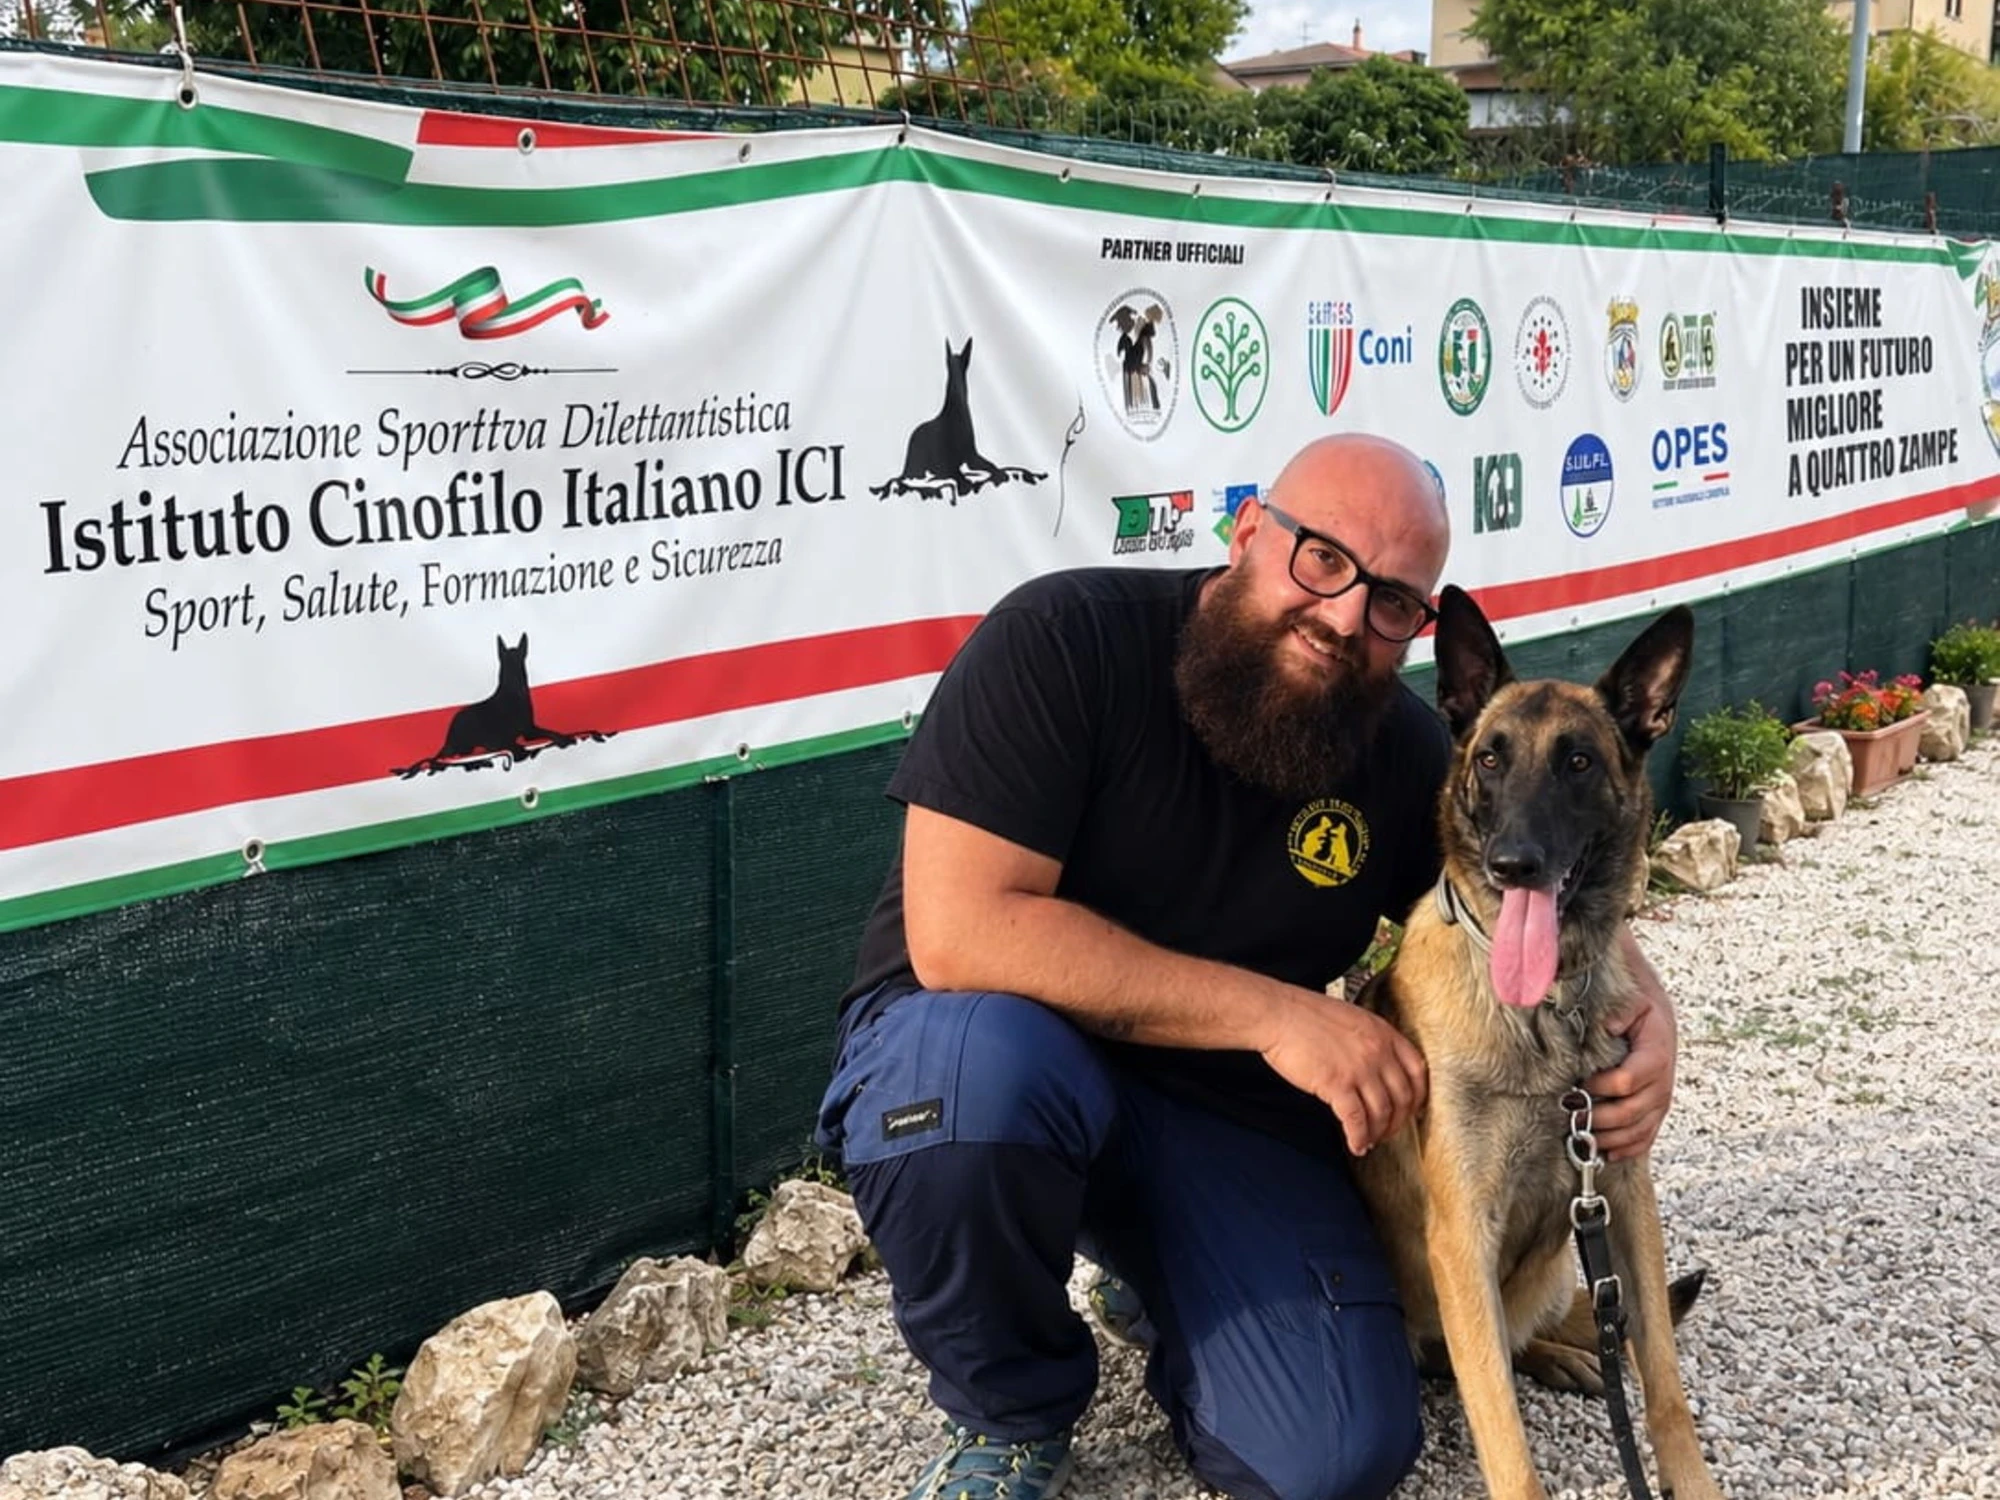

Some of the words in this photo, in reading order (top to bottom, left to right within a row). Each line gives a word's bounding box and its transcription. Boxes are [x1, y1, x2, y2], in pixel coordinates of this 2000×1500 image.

[1100, 237, 1173, 262] PARTNER
[1176, 241, 1245, 265] UFFICIALI
[1801, 286, 1882, 330] INSIEME
[1358, 325, 1412, 366] Coni
[1785, 340, 1824, 388] PER
[1828, 339, 1855, 383] UN
[1860, 335, 1933, 380] FUTURO
[116, 409, 361, 470] Associazione
[559, 391, 790, 449] Dilettantistica
[1786, 388, 1884, 443] MIGLIORE
[1651, 421, 1730, 472] OPES
[1787, 453, 1803, 498] A
[1806, 437, 1895, 498] QUATTRO
[1898, 427, 1959, 474] ZAMPE
[39, 489, 290, 575] Istituto
[309, 467, 543, 548] Cinofilo
[562, 458, 762, 529] Italiano
[775, 444, 846, 507] ICI
[144, 583, 266, 652] Sport,
[282, 569, 409, 622] Salute,
[421, 552, 614, 608] Formazione
[625, 555, 639, 584] e
[651, 537, 782, 581] Sicurezza
